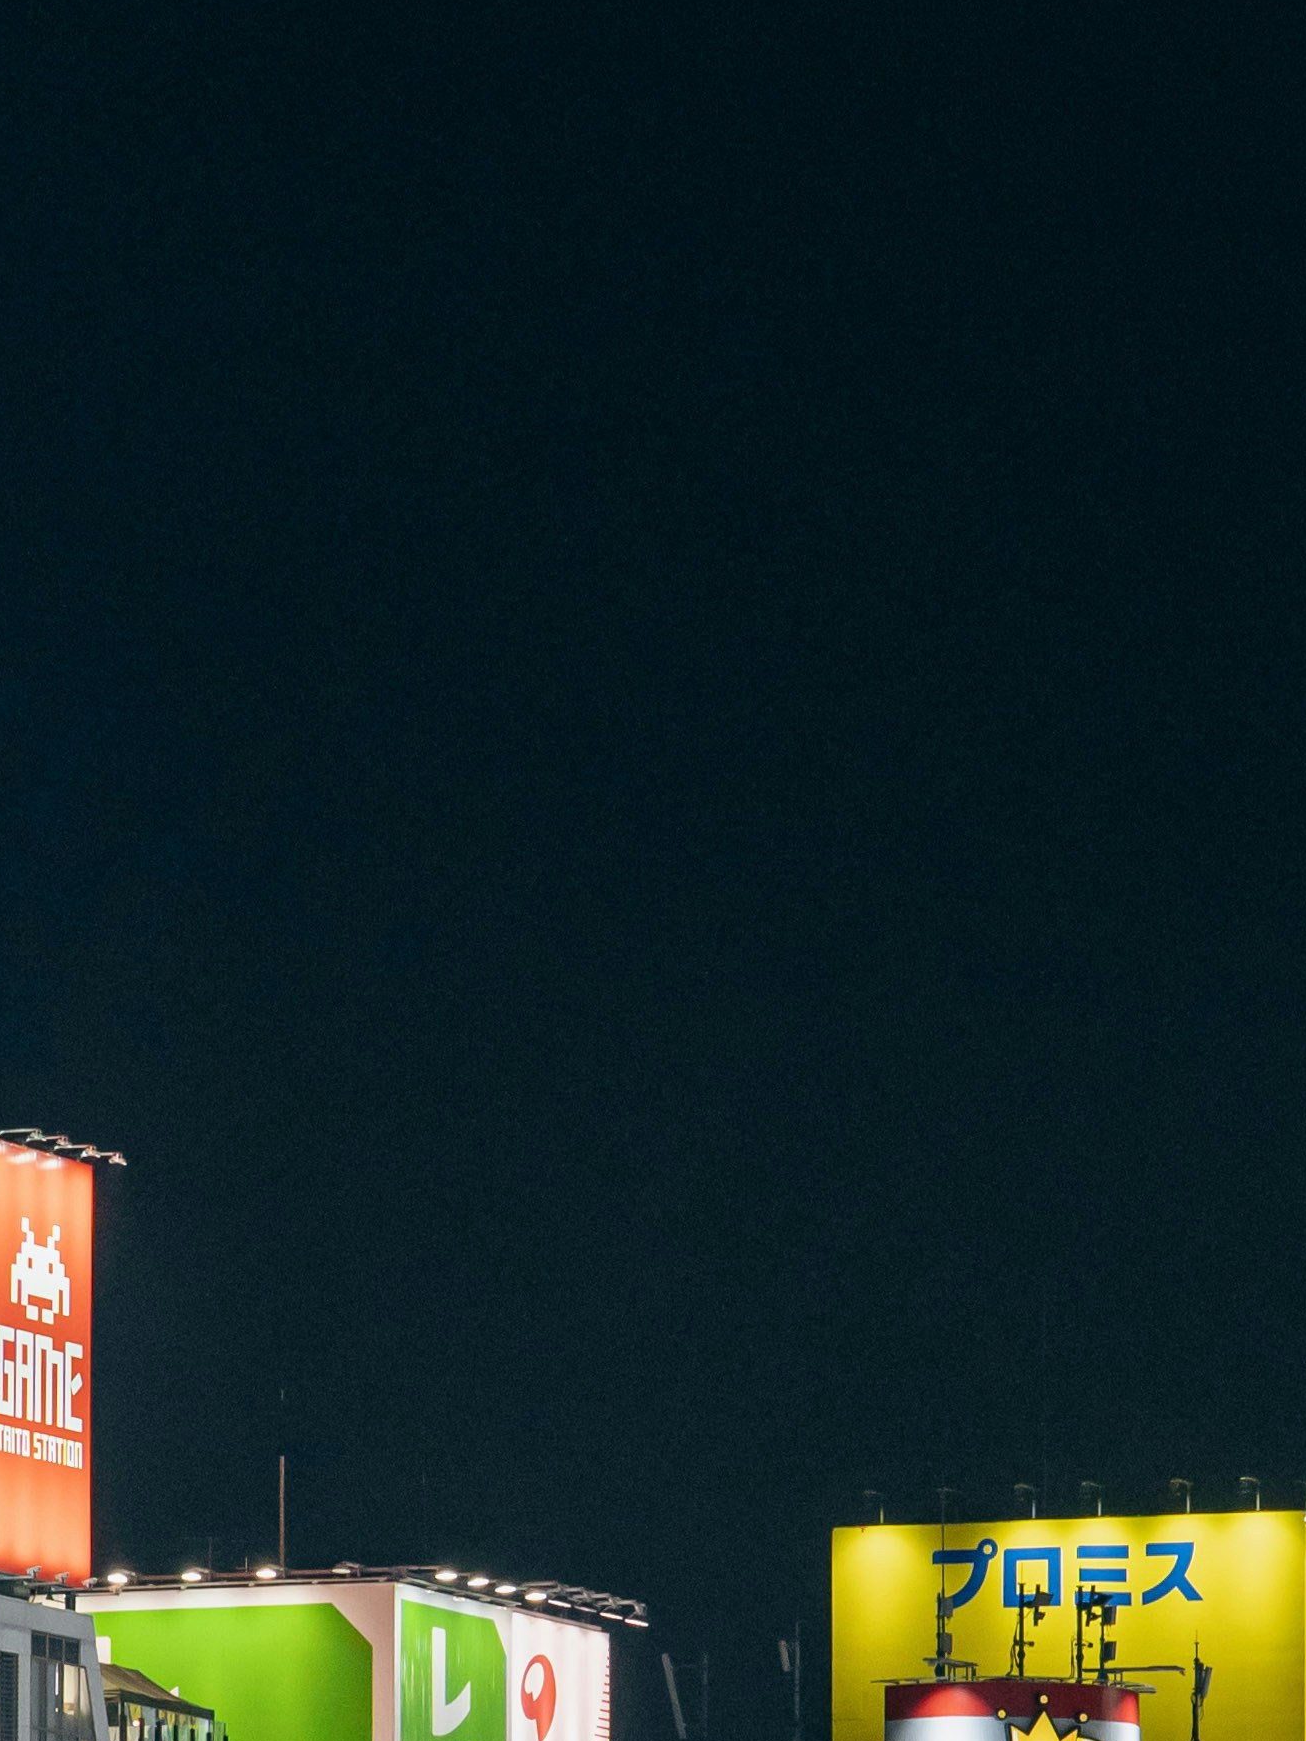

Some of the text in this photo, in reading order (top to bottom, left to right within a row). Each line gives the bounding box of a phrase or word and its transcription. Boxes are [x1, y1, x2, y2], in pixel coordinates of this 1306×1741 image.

[33, 1430, 83, 1470] STATION
[932, 1538, 1204, 1609] プロミス
